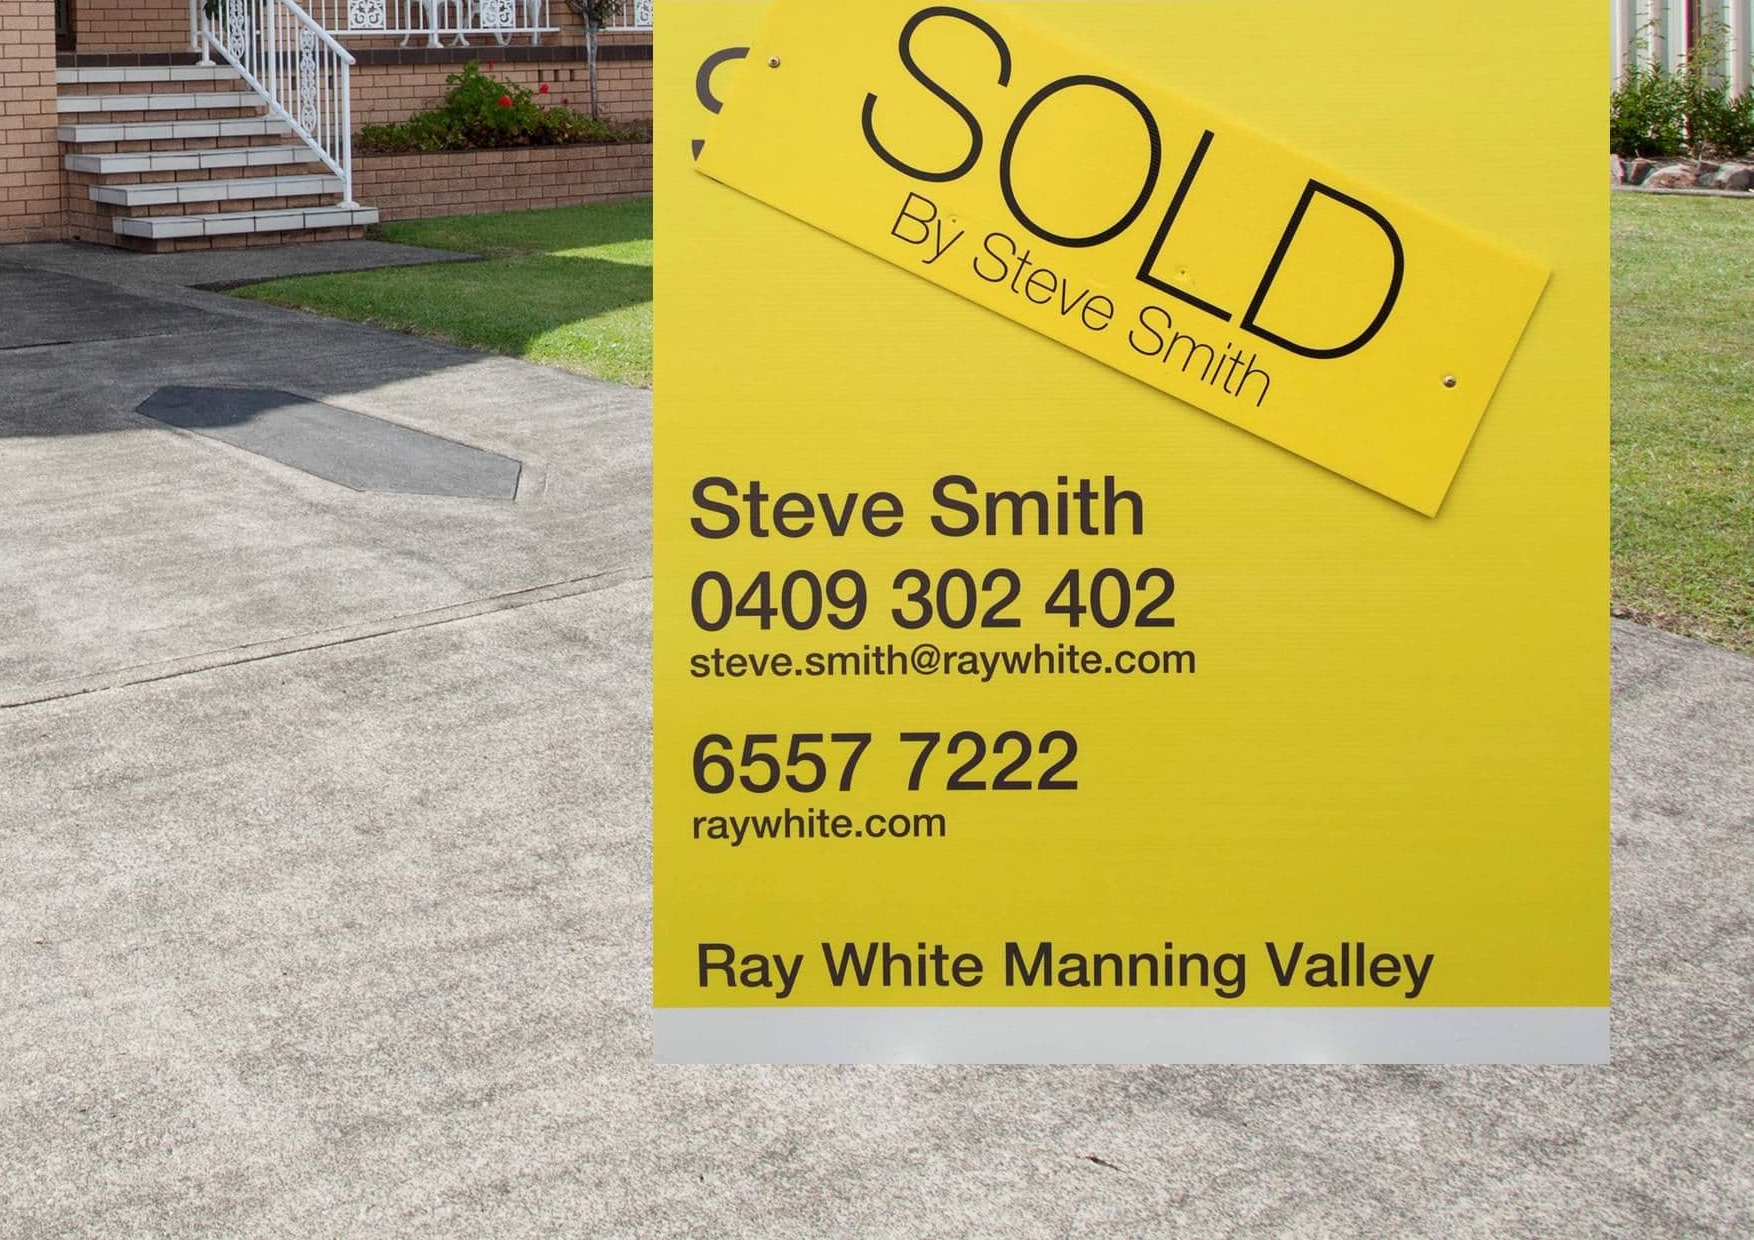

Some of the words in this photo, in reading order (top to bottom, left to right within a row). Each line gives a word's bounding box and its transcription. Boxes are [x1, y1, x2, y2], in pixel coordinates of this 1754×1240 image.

[861, 5, 1405, 360] SOLD
[890, 191, 965, 265] By
[972, 231, 1115, 332] Steve
[1128, 304, 1272, 408] Smith
[689, 475, 904, 539] Steve
[930, 475, 1145, 538] Smith
[689, 569, 869, 632] 0409
[891, 568, 1022, 630] 302
[1044, 567, 1176, 629] 402
[689, 643, 1197, 683] steve.smith@raywhite.com
[692, 732, 872, 795] 6557
[899, 729, 1080, 791] 7222
[692, 807, 947, 848] raywhite.com
[698, 942, 805, 1000] Ray
[821, 941, 984, 988] White
[1004, 941, 1247, 1000] Manning
[1264, 941, 1435, 1000] Valley
